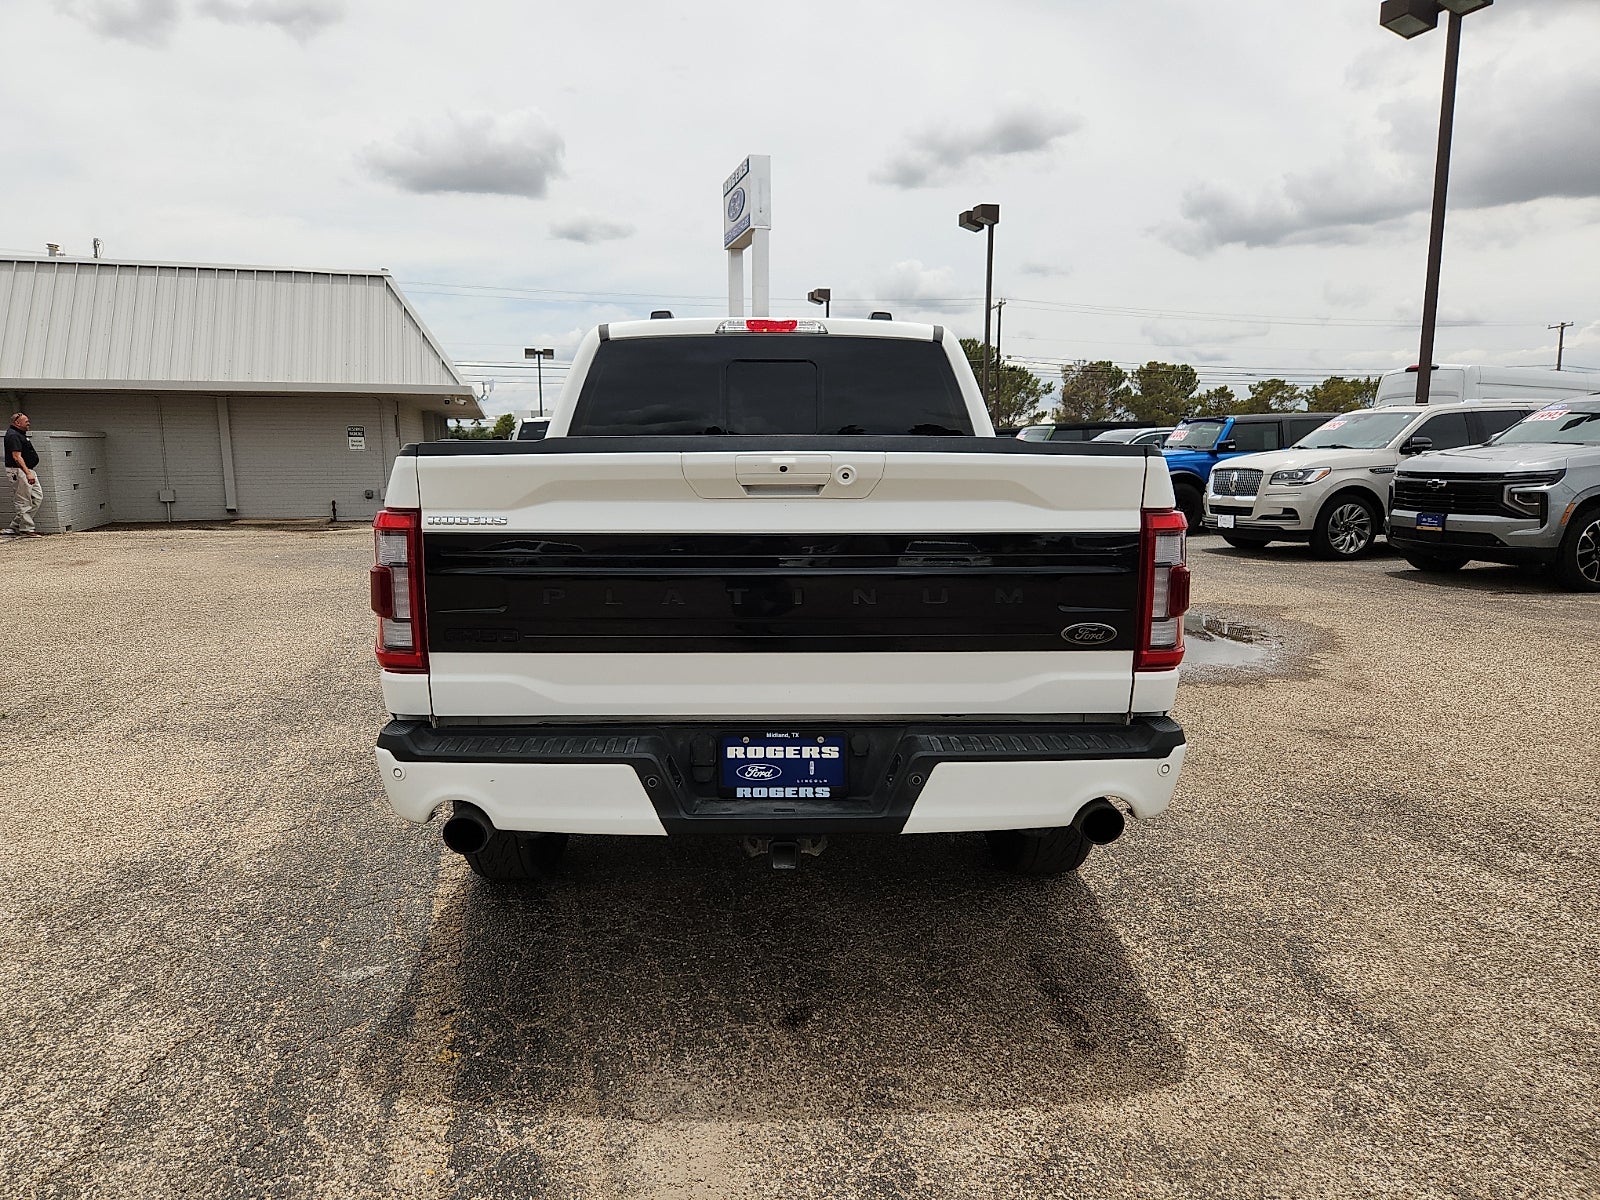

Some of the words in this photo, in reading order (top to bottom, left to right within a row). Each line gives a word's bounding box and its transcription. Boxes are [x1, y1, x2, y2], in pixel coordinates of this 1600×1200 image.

[427, 516, 508, 526] ROGERS
[542, 588, 1024, 605] PLATINUM
[1074, 627, 1106, 640] Ford
[726, 746, 840, 759] ROGERS
[744, 765, 773, 778] Ford
[736, 787, 831, 798] ROGERS
